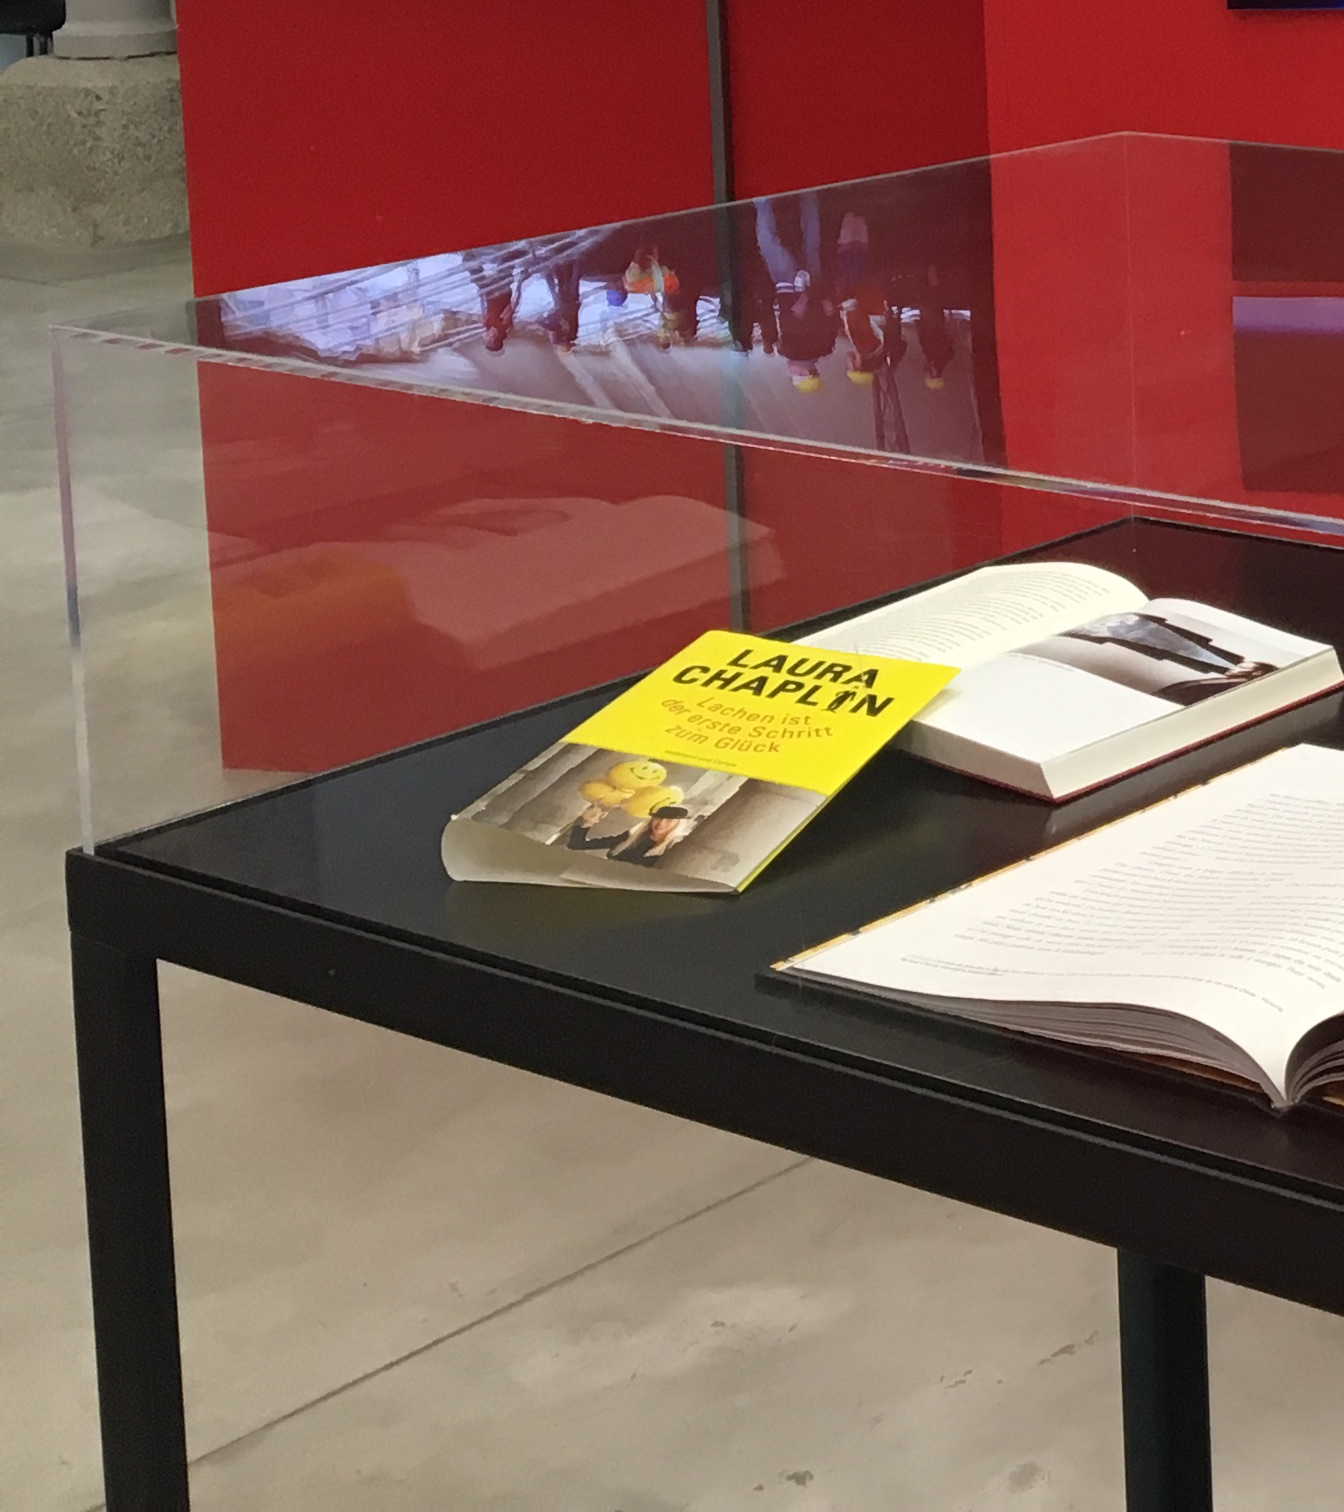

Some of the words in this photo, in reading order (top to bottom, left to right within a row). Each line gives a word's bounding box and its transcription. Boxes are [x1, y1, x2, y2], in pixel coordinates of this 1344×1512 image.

[726, 649, 880, 689] LAURA
[672, 665, 896, 717] CHAPLIN
[696, 696, 776, 724] Lachen
[780, 713, 812, 726] ist
[661, 697, 692, 718] der
[687, 713, 743, 736] erste
[748, 725, 834, 740] Schritt
[664, 725, 710, 746] zum
[714, 736, 780, 754] Glück
